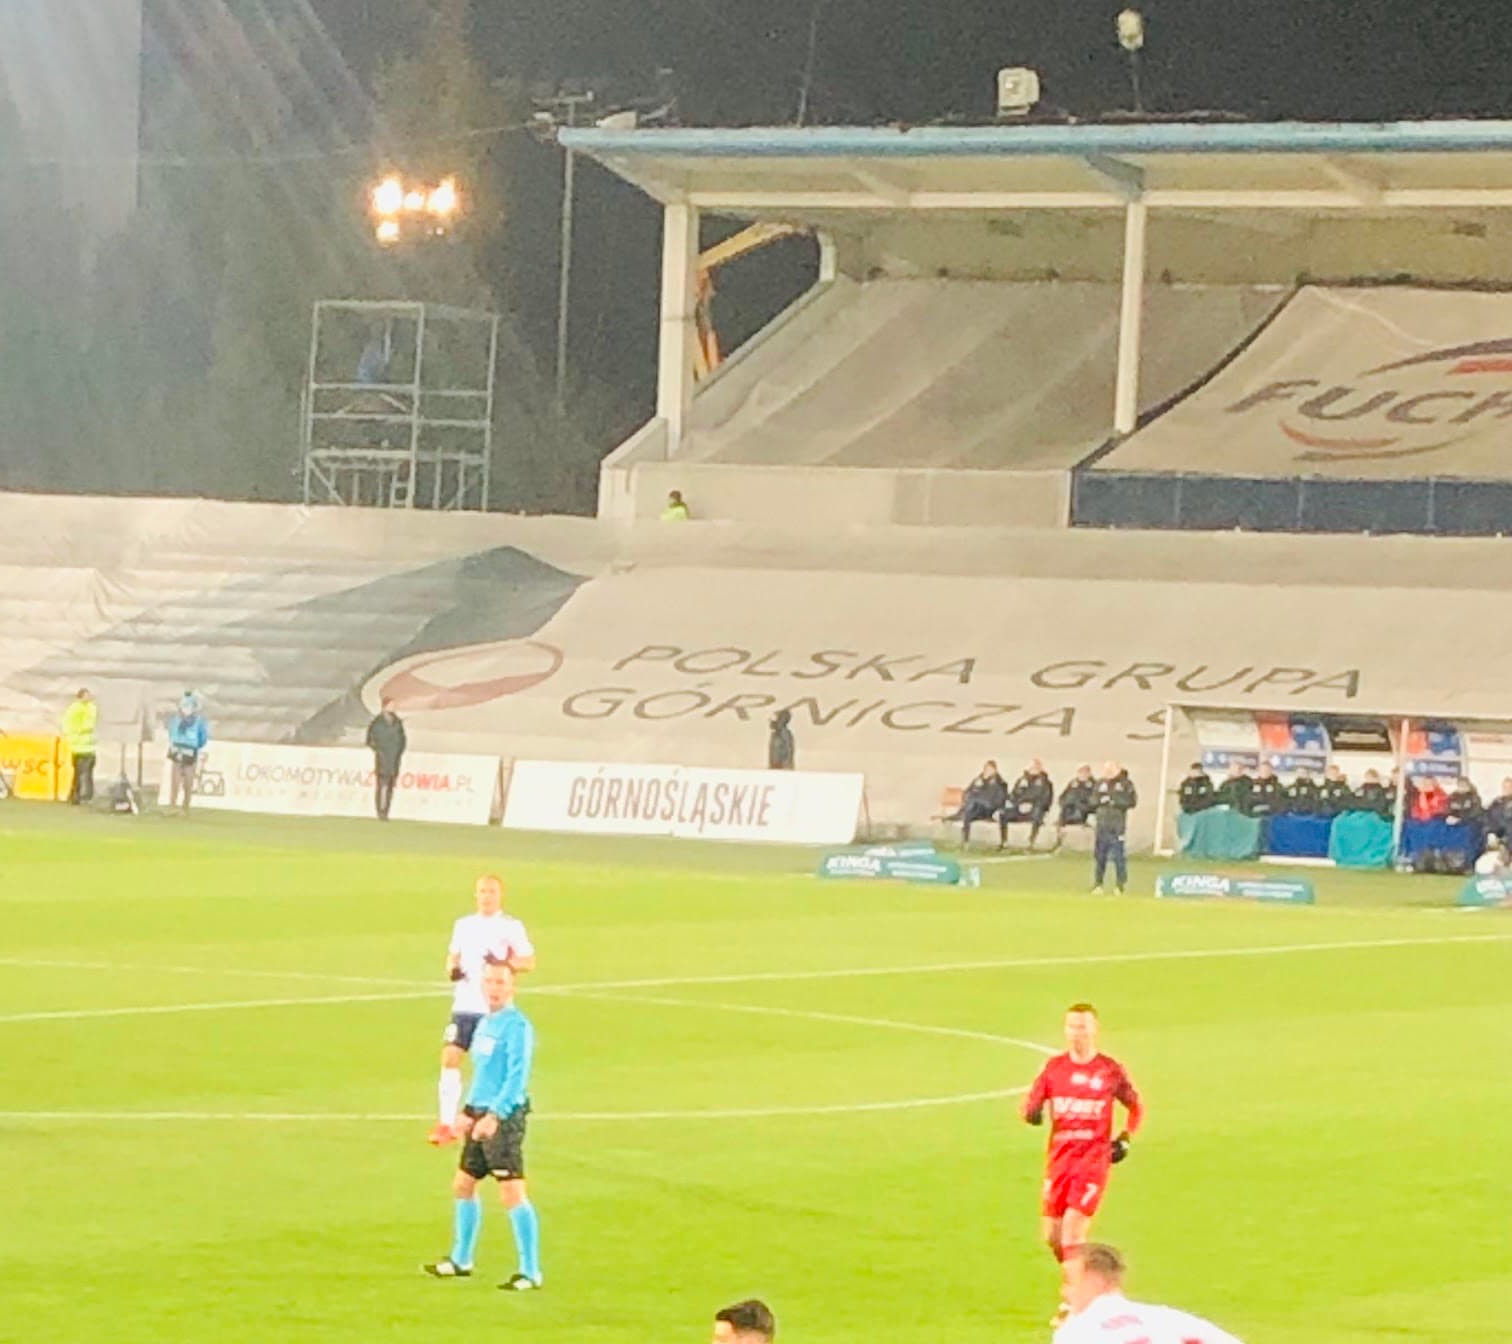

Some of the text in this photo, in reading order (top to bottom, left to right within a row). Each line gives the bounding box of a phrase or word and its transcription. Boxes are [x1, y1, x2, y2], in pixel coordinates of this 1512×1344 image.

[611, 644, 1360, 699] POLSKA GRUPA
[562, 682, 1076, 739] GÓRNICZA
[567, 766, 777, 833] GÓRNOŚLĄSKIE
